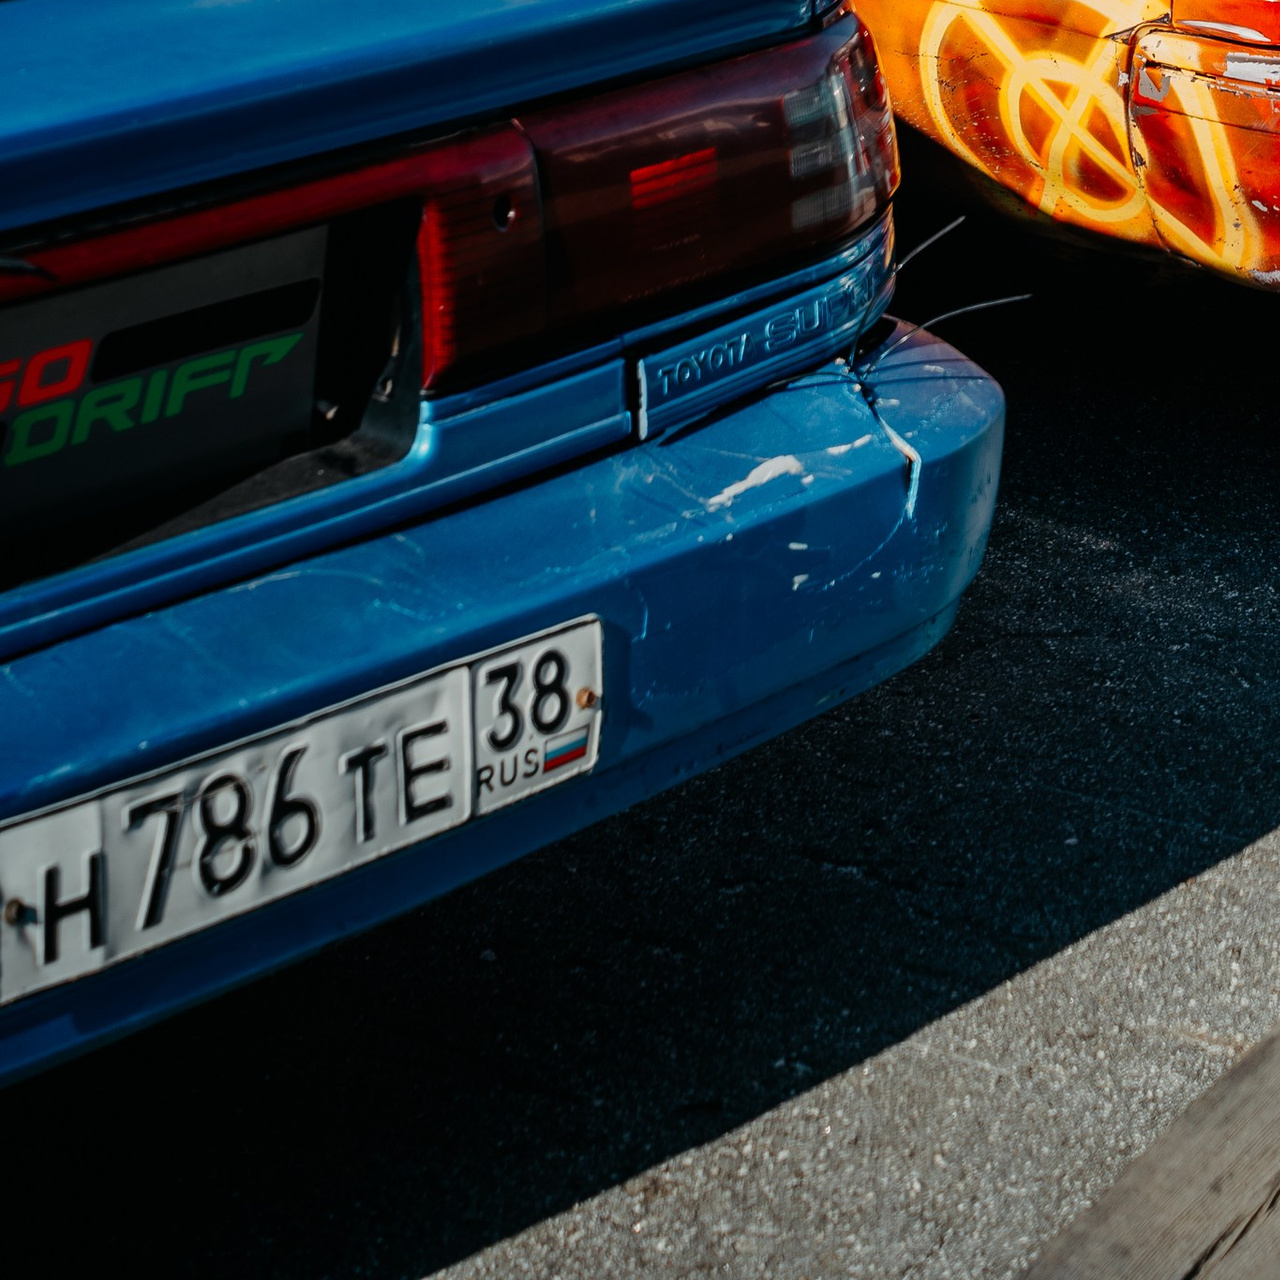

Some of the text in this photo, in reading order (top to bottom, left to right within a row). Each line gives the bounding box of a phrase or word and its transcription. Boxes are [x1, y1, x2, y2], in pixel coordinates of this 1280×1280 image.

[657, 332, 752, 396] TOYOTA
[484, 649, 570, 751] 38
[475, 746, 540, 794] RUS
